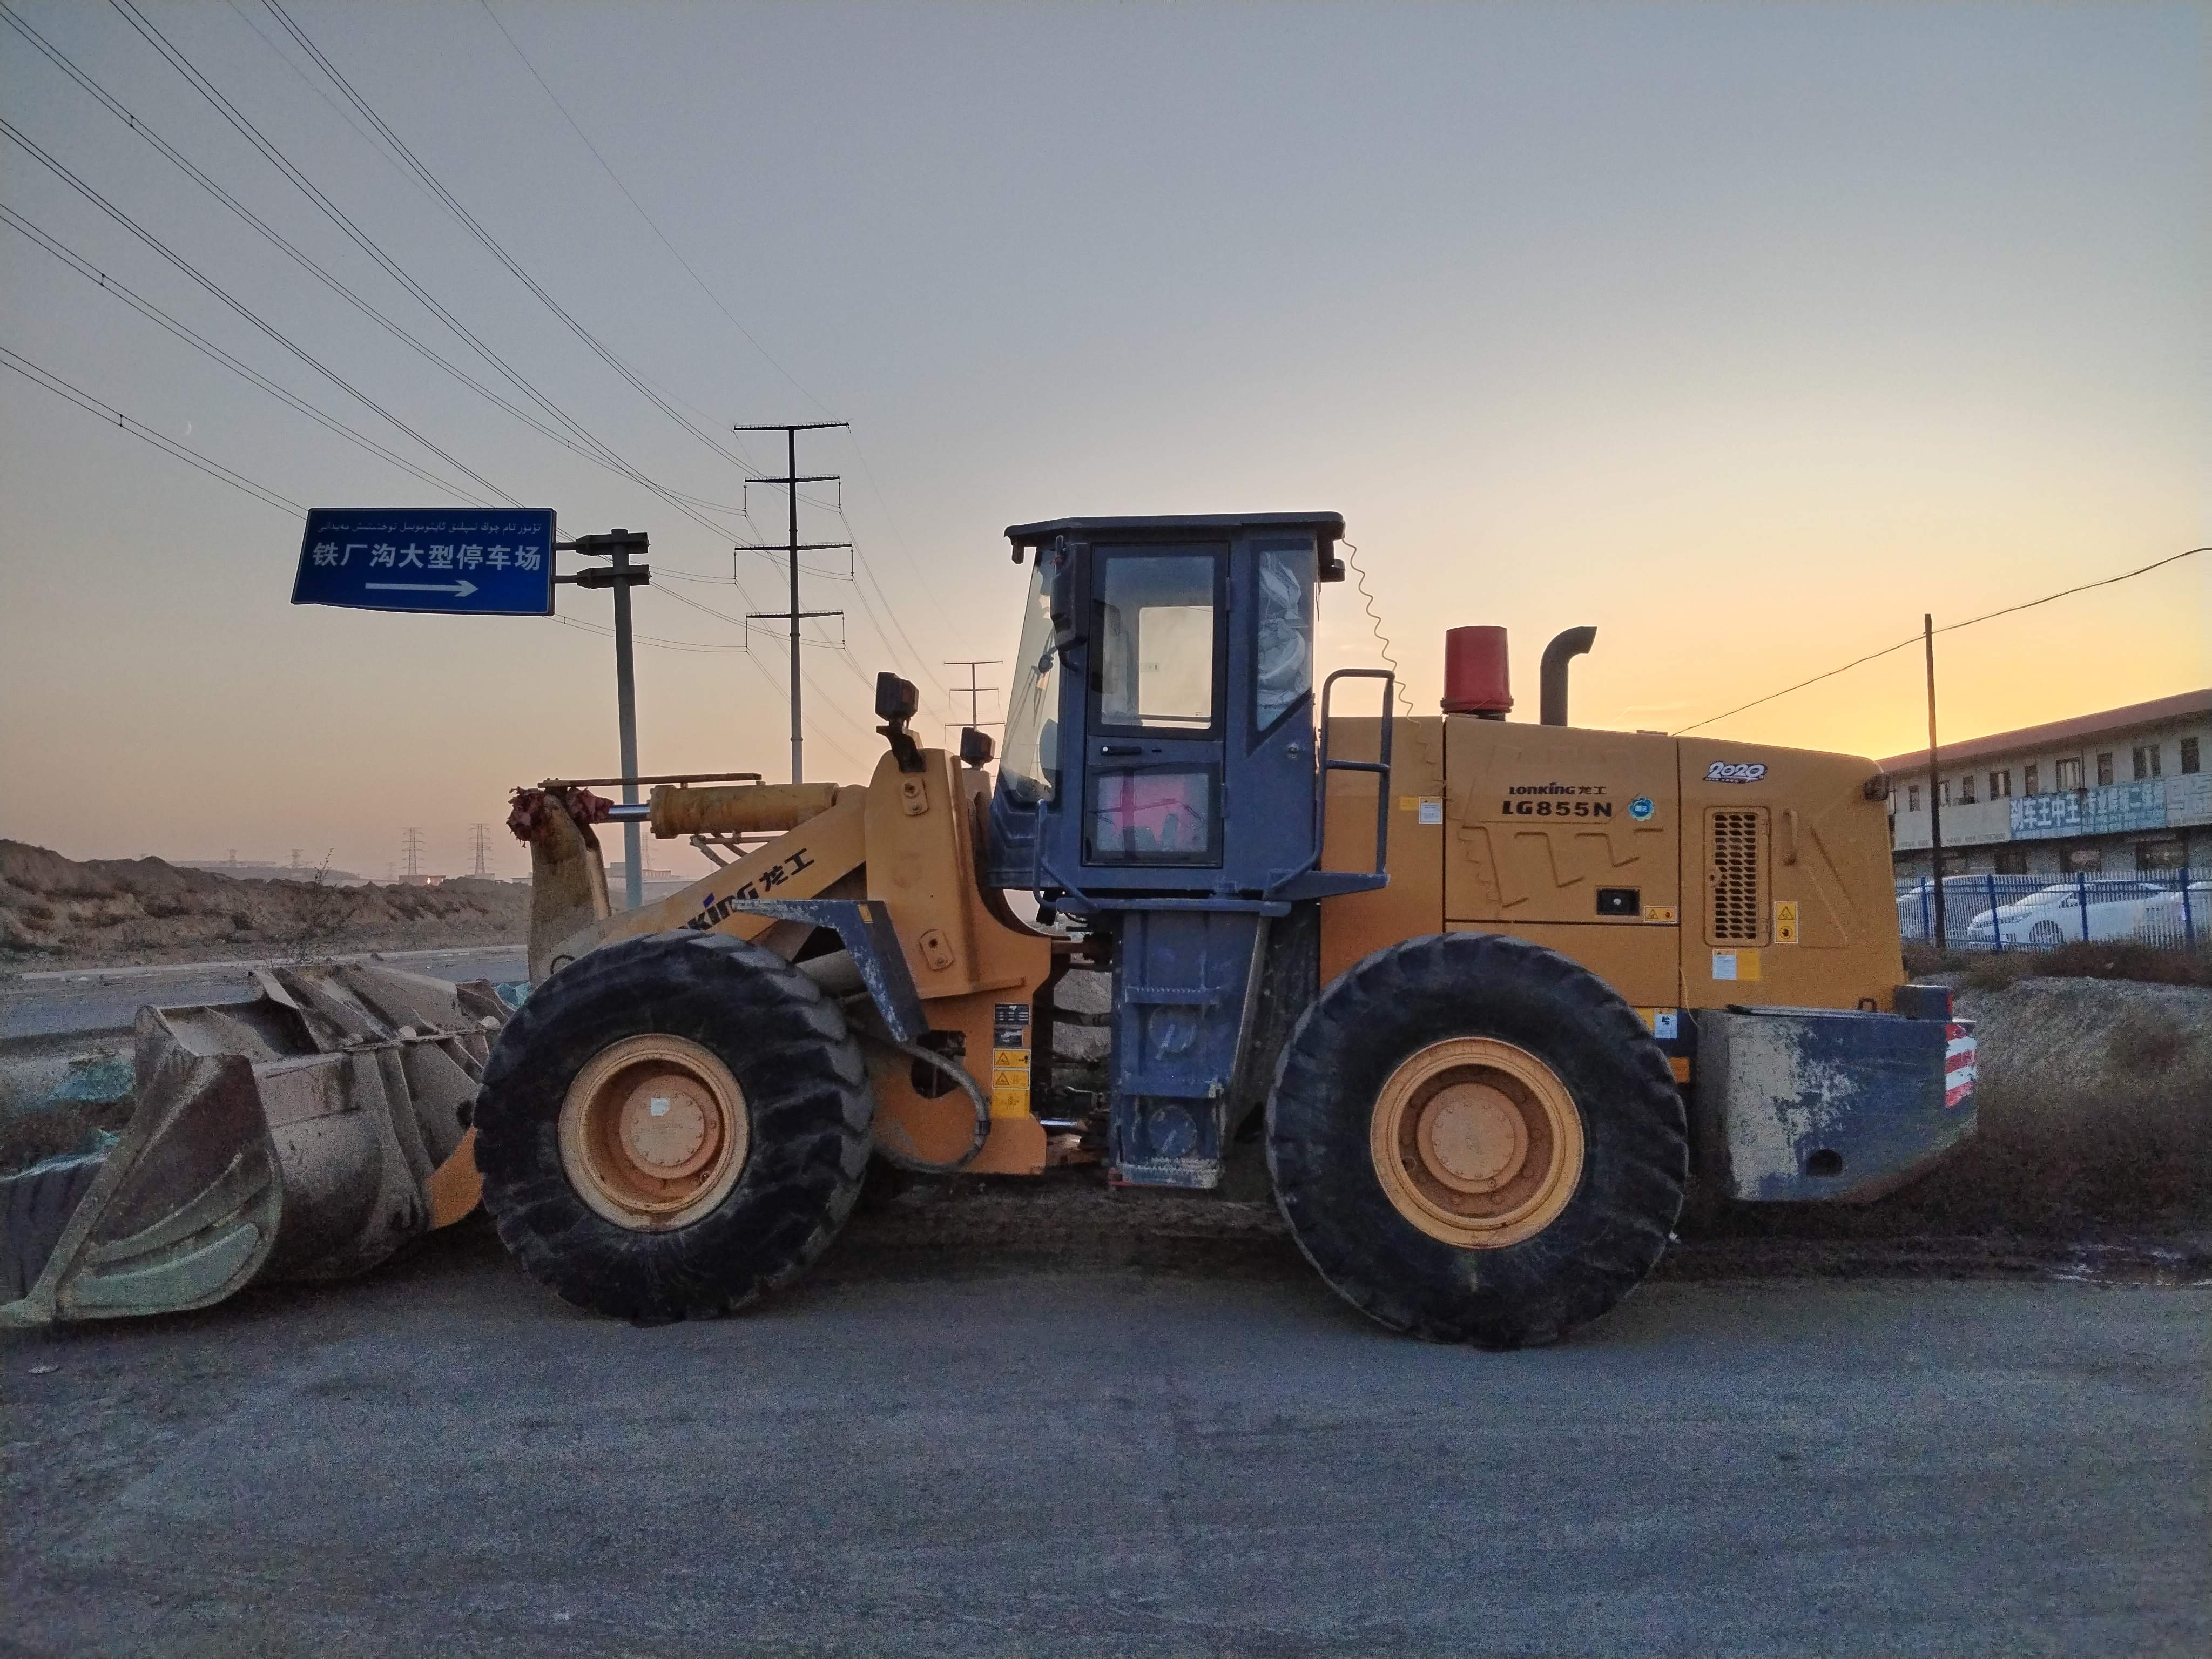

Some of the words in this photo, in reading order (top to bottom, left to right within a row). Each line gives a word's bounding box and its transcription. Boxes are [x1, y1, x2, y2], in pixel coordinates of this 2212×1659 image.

[312, 541, 541, 571] 铁厂沟大型停车场
[1707, 761, 1765, 778] 2020
[1578, 785, 1608, 795] 龙工
[1501, 800, 1613, 817] LG855N
[2010, 793, 2081, 831] 刹车王中王
[758, 848, 815, 892] 龙工
